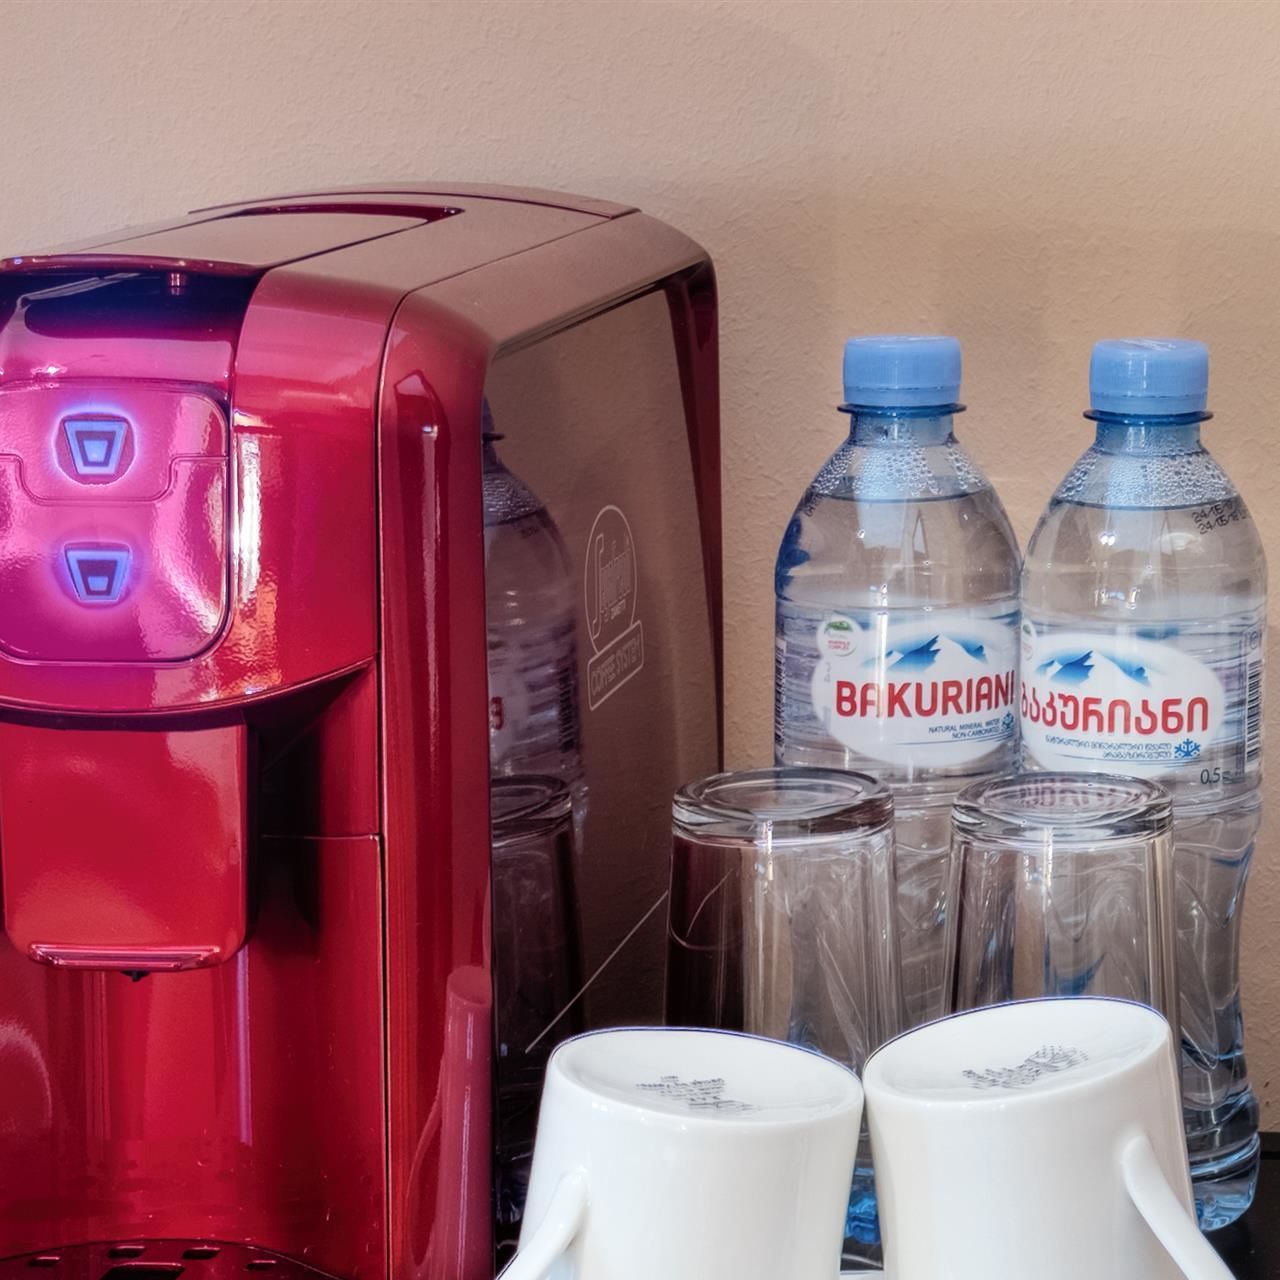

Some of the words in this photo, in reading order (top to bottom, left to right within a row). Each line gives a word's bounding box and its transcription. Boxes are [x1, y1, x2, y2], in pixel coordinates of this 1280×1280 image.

[835, 670, 1015, 718] BAKURIANI
[1021, 682, 1209, 735] ბაკურიანი
[928, 725, 957, 734] NATURAL
